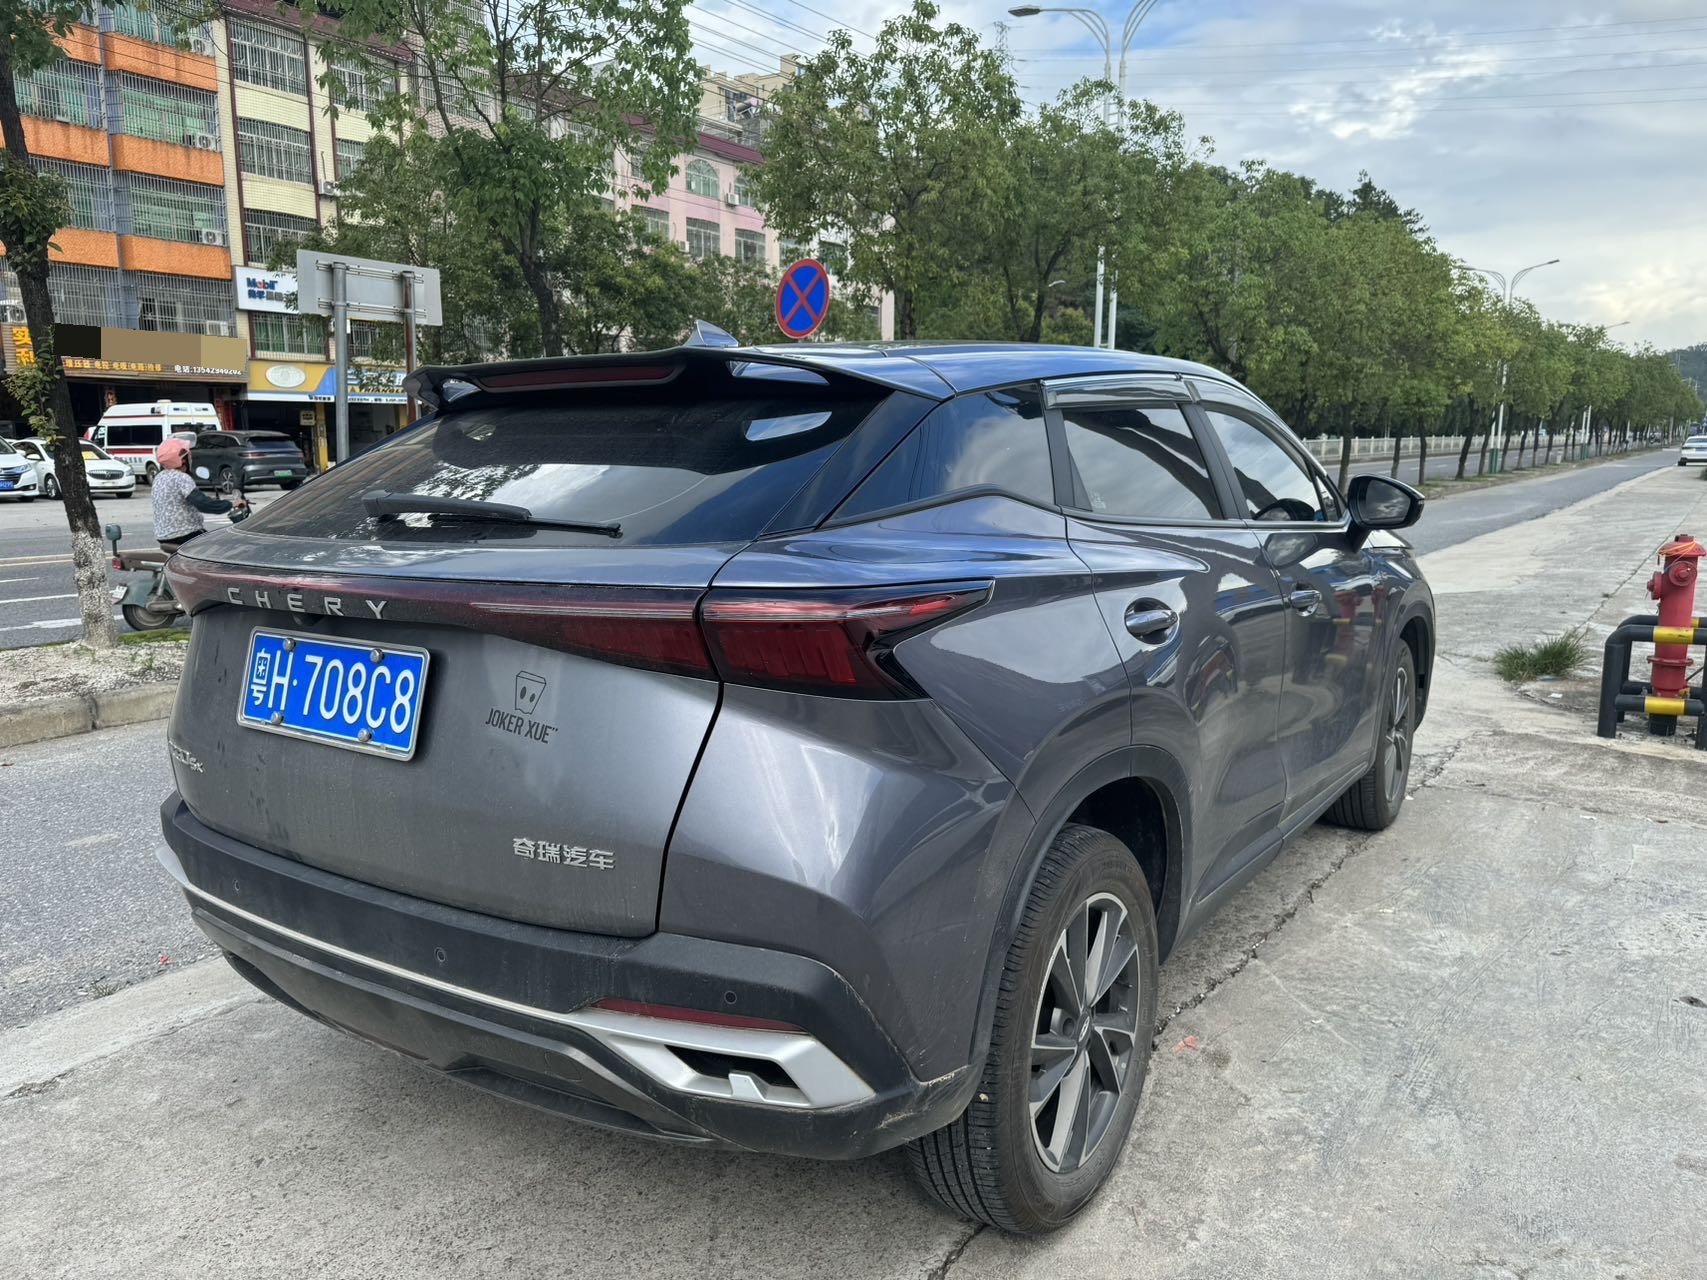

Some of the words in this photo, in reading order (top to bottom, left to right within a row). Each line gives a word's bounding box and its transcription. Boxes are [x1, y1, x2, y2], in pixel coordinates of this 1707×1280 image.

[246, 277, 278, 290] Mobil
[227, 587, 388, 620] CHERY
[485, 708, 524, 735] JOKER
[512, 838, 615, 870] 奇瑞汽车
